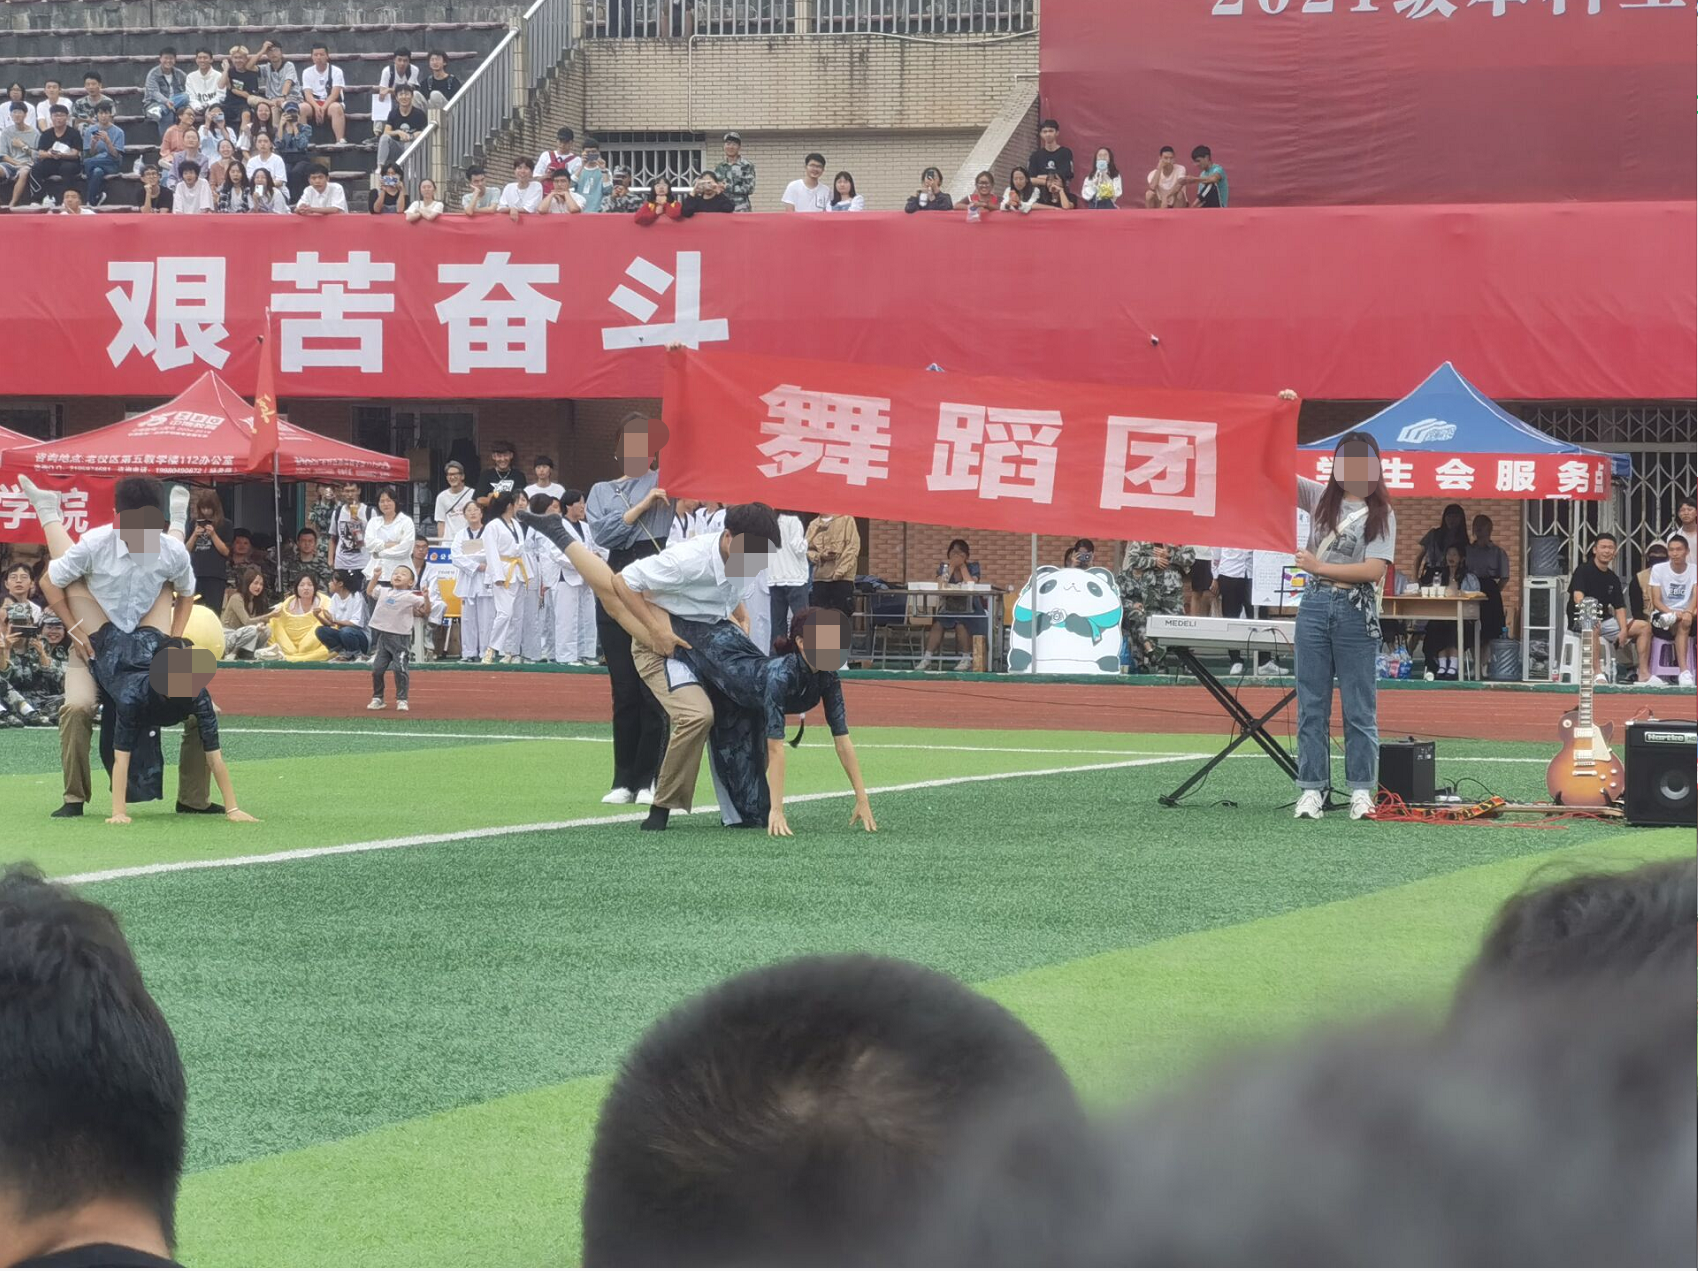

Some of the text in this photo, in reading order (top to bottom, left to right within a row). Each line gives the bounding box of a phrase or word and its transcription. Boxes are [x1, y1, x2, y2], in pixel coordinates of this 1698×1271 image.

[105, 251, 730, 374] 艰苦奋斗
[756, 384, 1218, 517] 舞蹈团
[0, 483, 89, 533] 学院
[1165, 619, 1197, 627] MEDELI
[1647, 734, 1684, 742] Hartke
